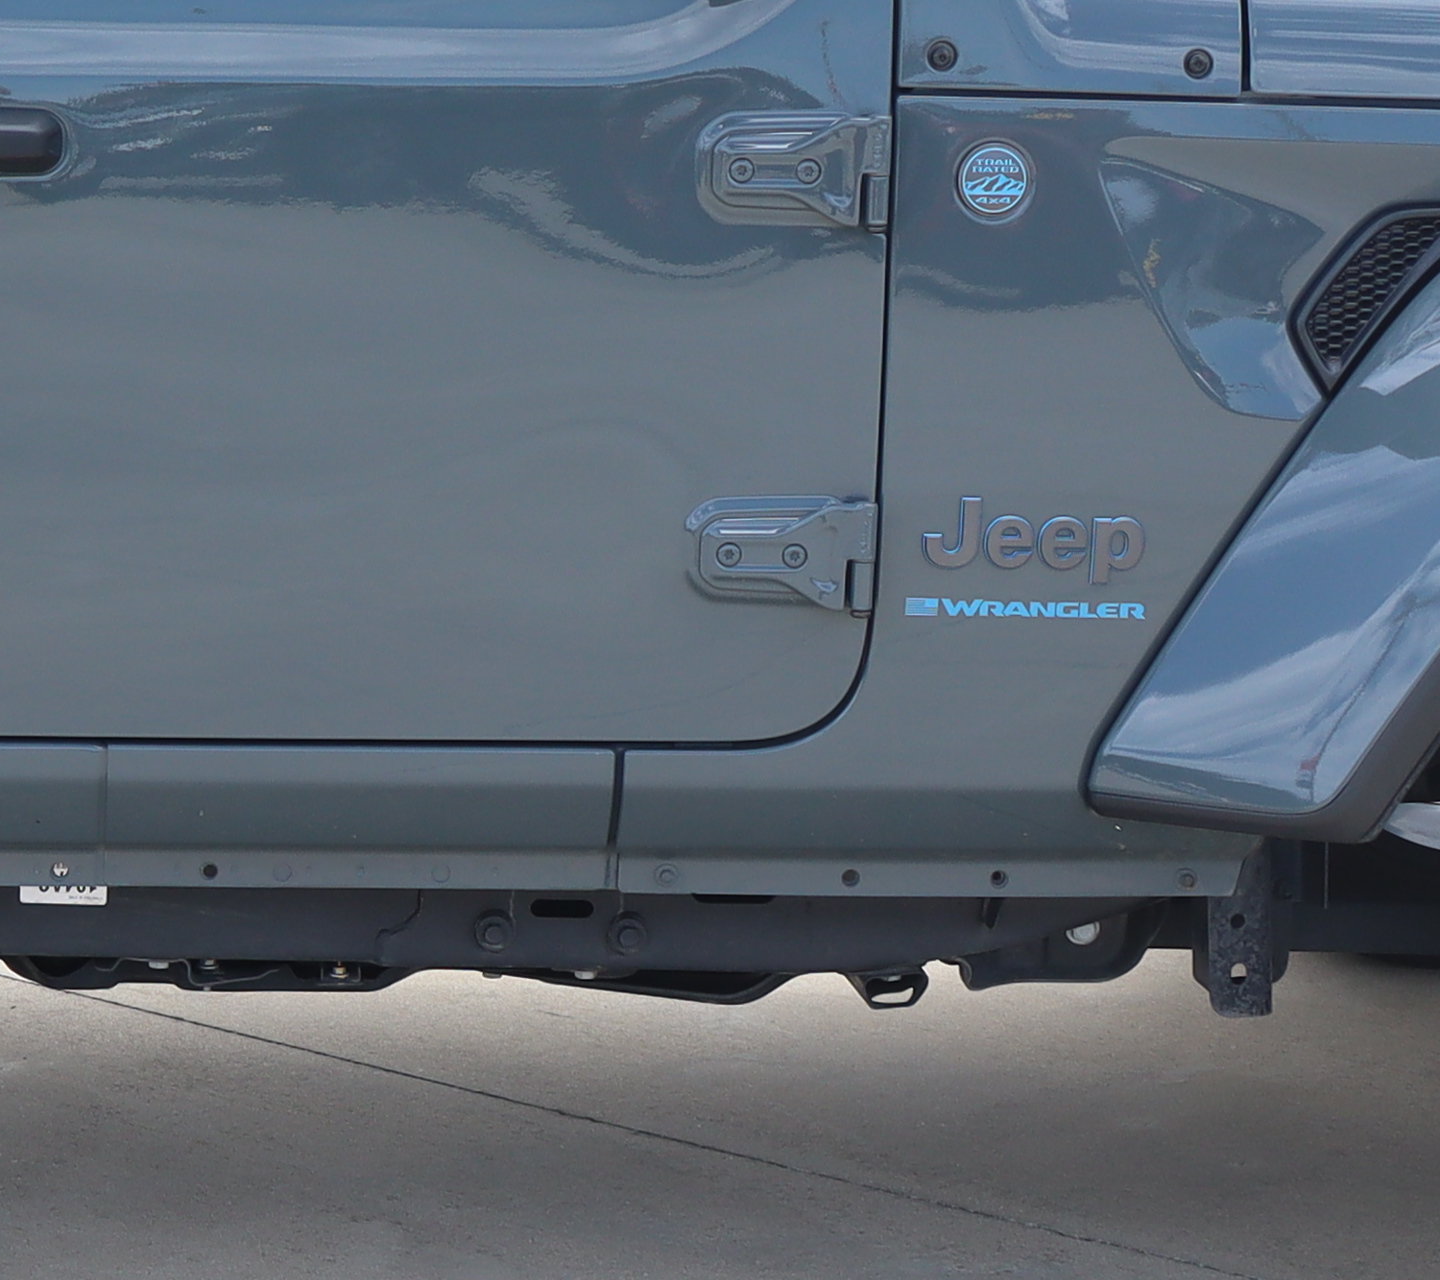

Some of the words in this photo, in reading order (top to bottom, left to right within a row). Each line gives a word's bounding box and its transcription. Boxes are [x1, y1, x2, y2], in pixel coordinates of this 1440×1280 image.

[972, 165, 1019, 173] RATED
[975, 158, 1015, 166] TRAIL
[921, 496, 1146, 585] Jeep
[941, 598, 1146, 620] WRANGLER
